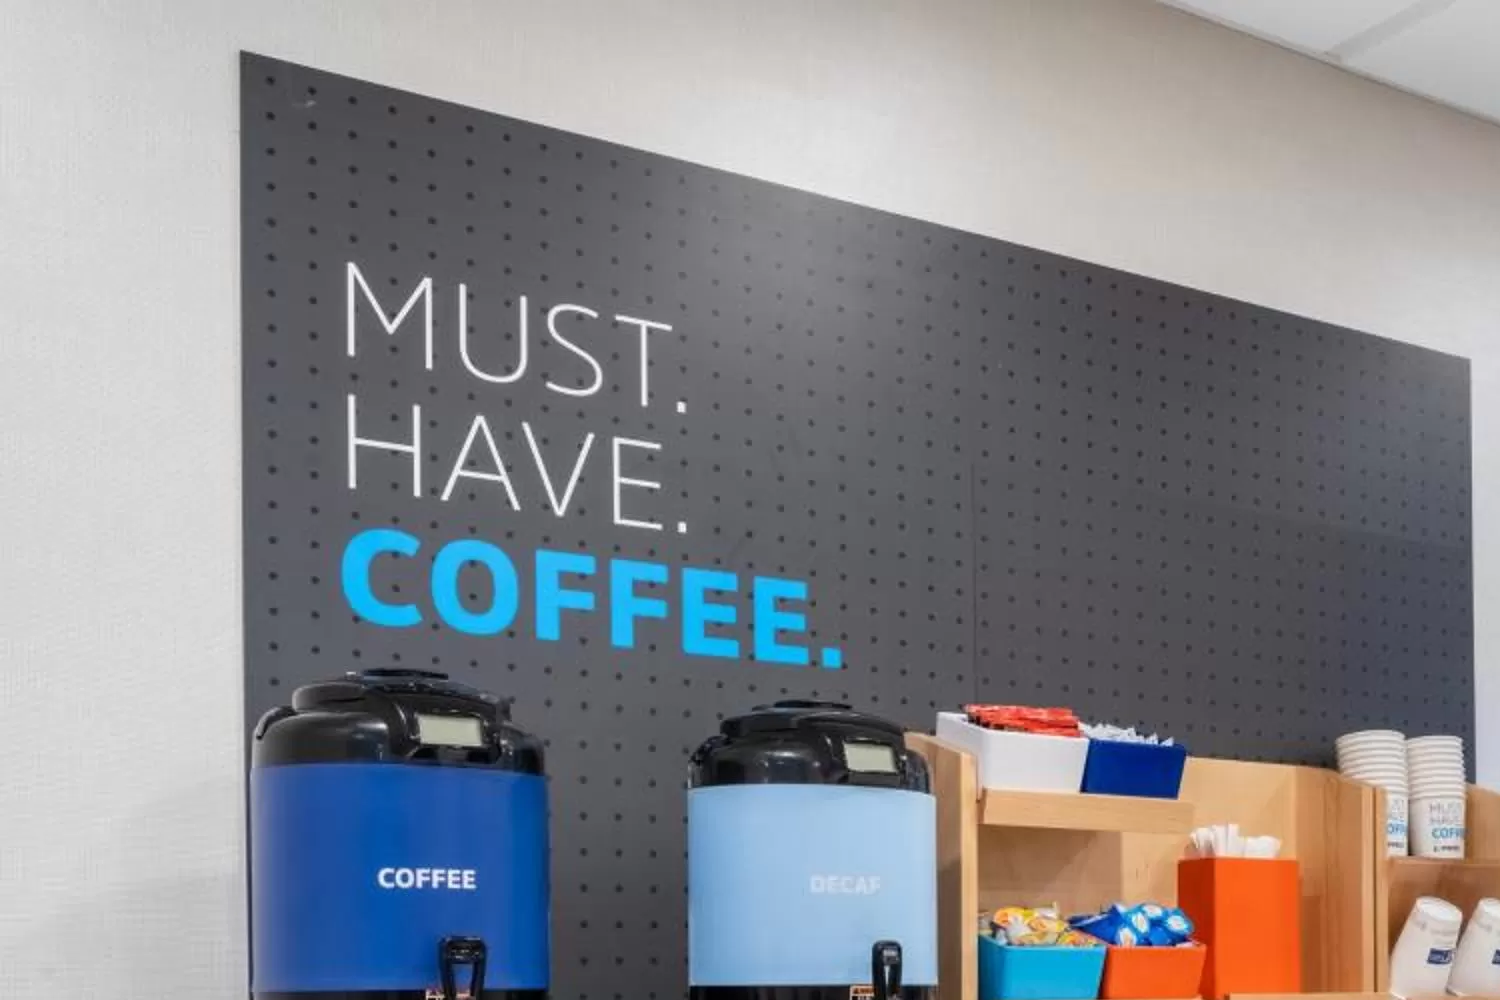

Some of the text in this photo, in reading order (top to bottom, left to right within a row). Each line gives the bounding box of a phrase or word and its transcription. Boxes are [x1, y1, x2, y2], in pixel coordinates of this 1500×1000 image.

[346, 261, 687, 413] MUST.
[347, 394, 687, 533] HAVE.
[341, 528, 842, 668] COFFEE.
[377, 867, 477, 890] COFFEE
[810, 874, 881, 895] DECAF
